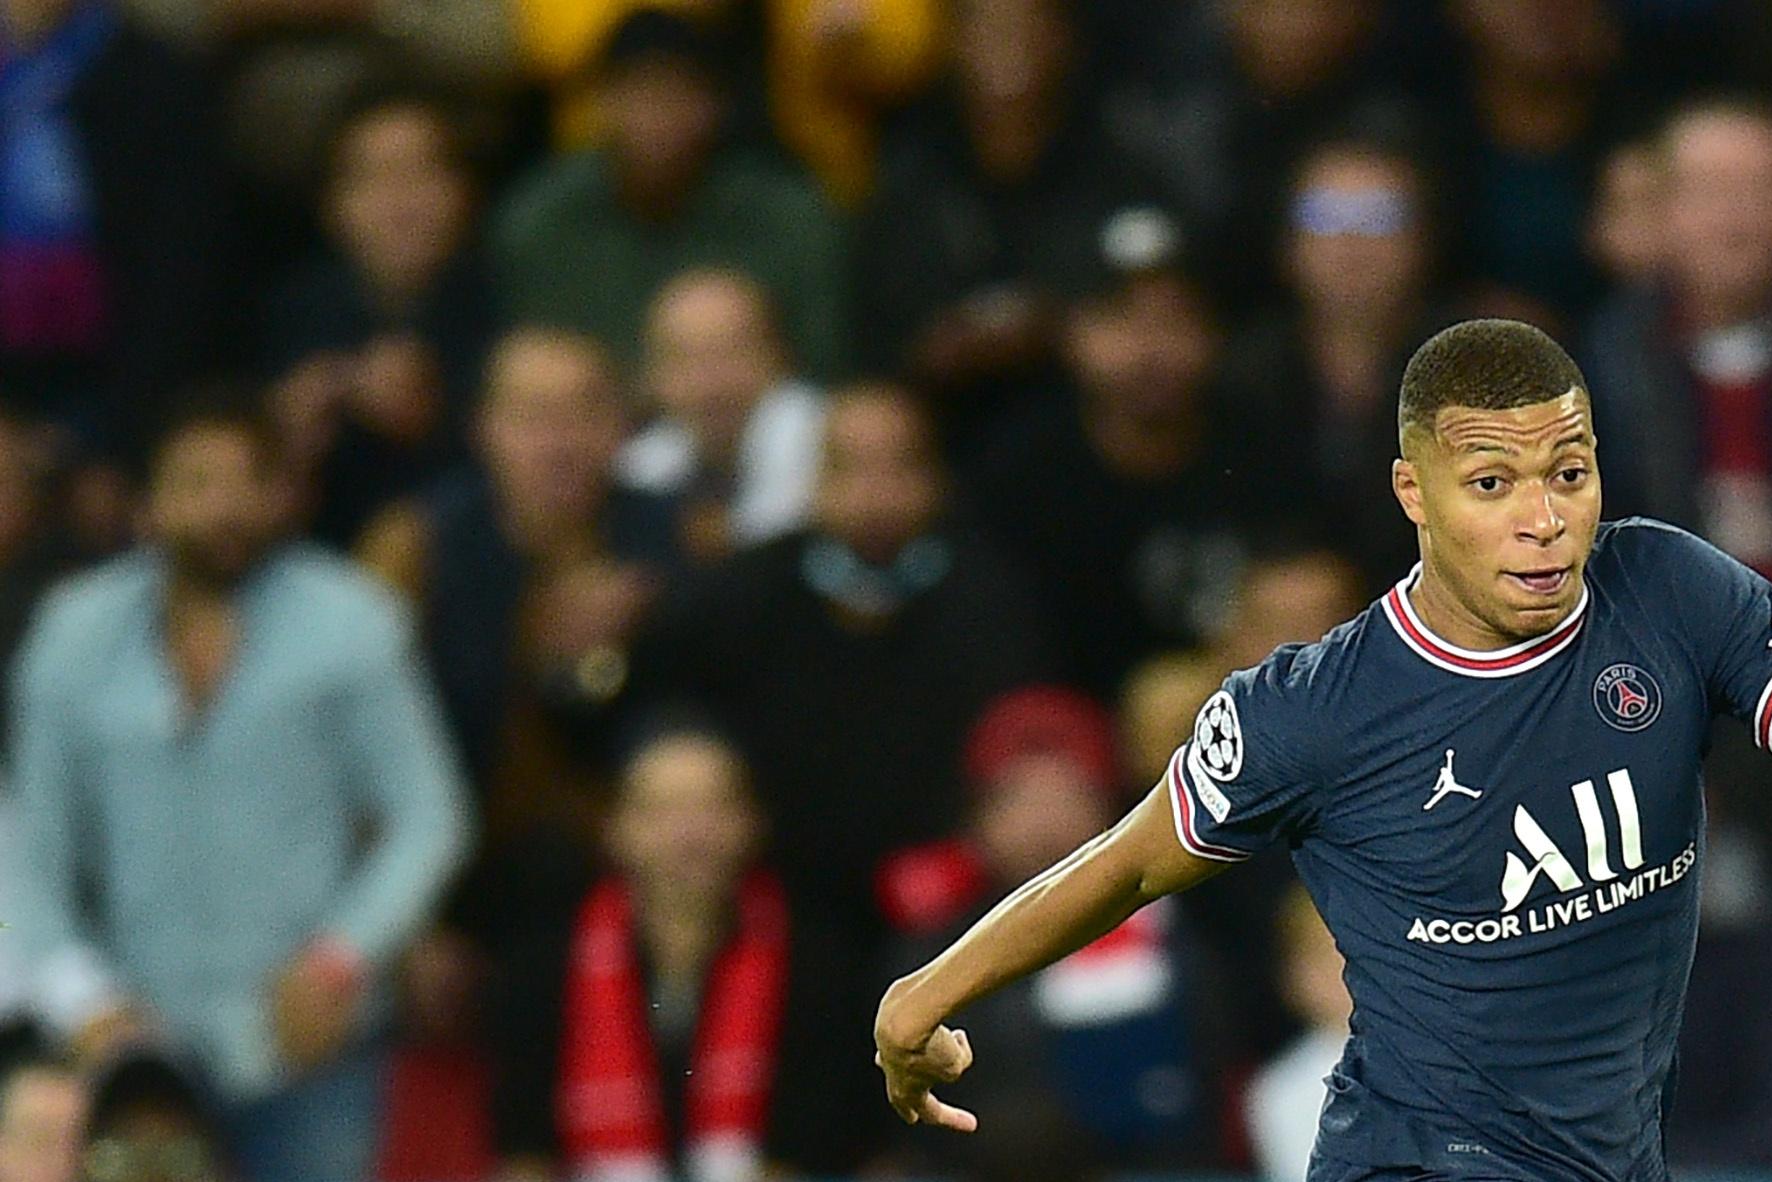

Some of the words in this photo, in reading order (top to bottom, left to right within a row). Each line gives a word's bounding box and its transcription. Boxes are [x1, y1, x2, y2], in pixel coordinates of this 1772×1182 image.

[1598, 667, 1637, 692] PARIS
[1406, 916, 1523, 944] ACCOR
[1528, 894, 1593, 935] LIVE
[1599, 841, 1695, 914] LIMITLESS
